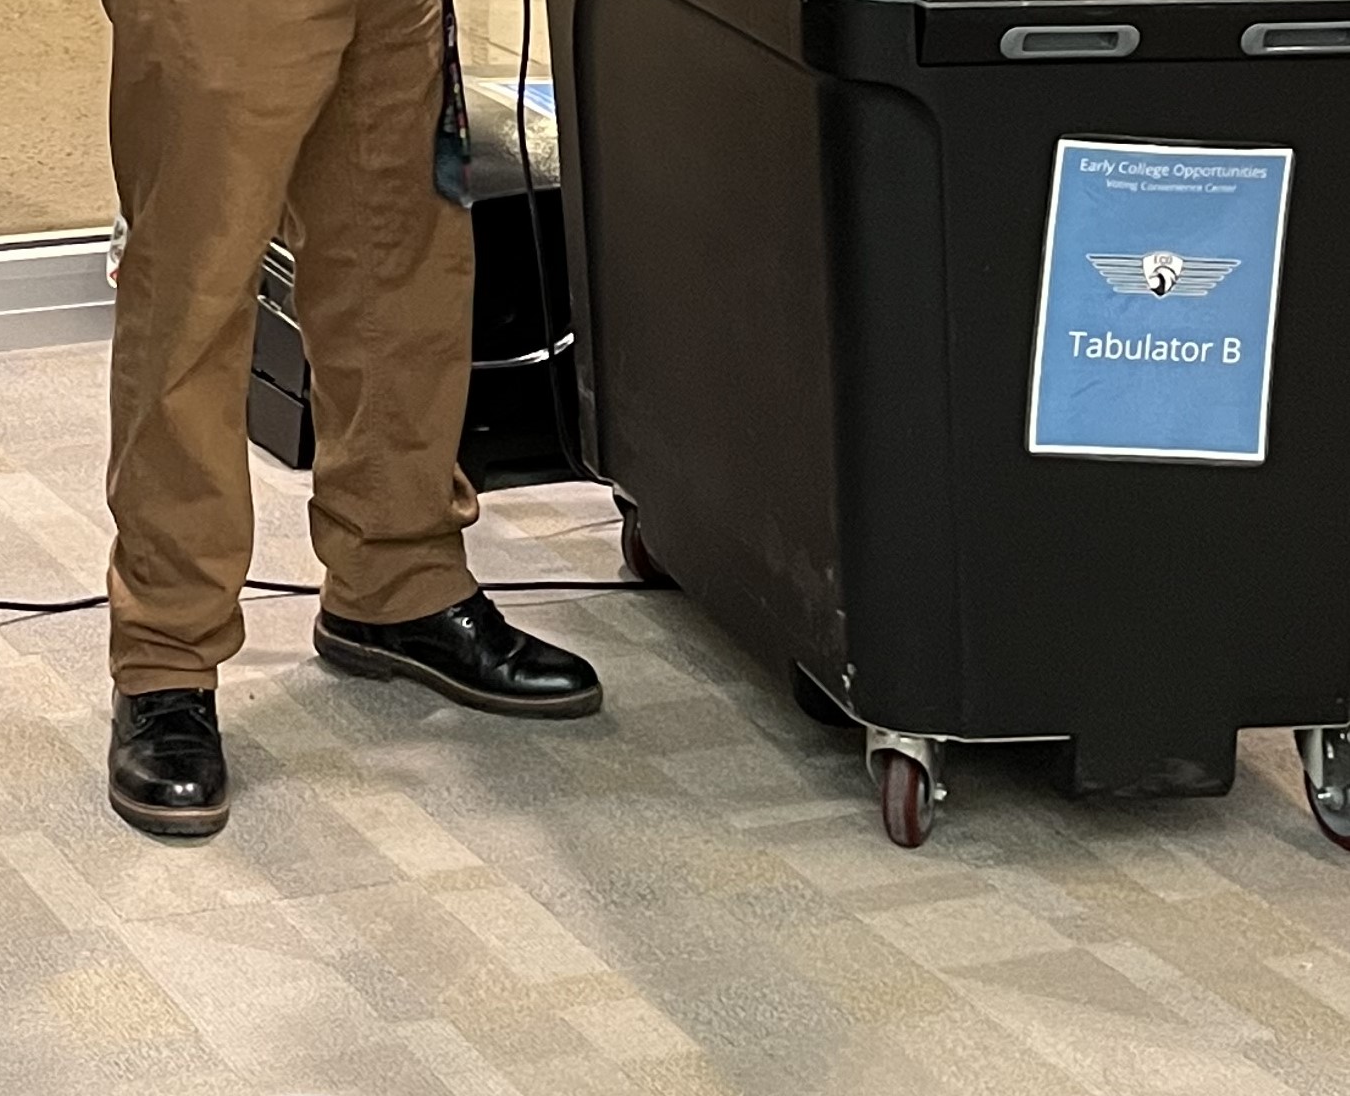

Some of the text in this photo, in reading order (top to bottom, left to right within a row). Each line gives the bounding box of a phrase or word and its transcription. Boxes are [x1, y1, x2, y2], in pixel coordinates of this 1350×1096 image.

[1079, 158, 1268, 179] Early College Opportunities
[1106, 179, 1238, 194] Voting Convenience Center
[1068, 331, 1242, 364] Tabulator B
